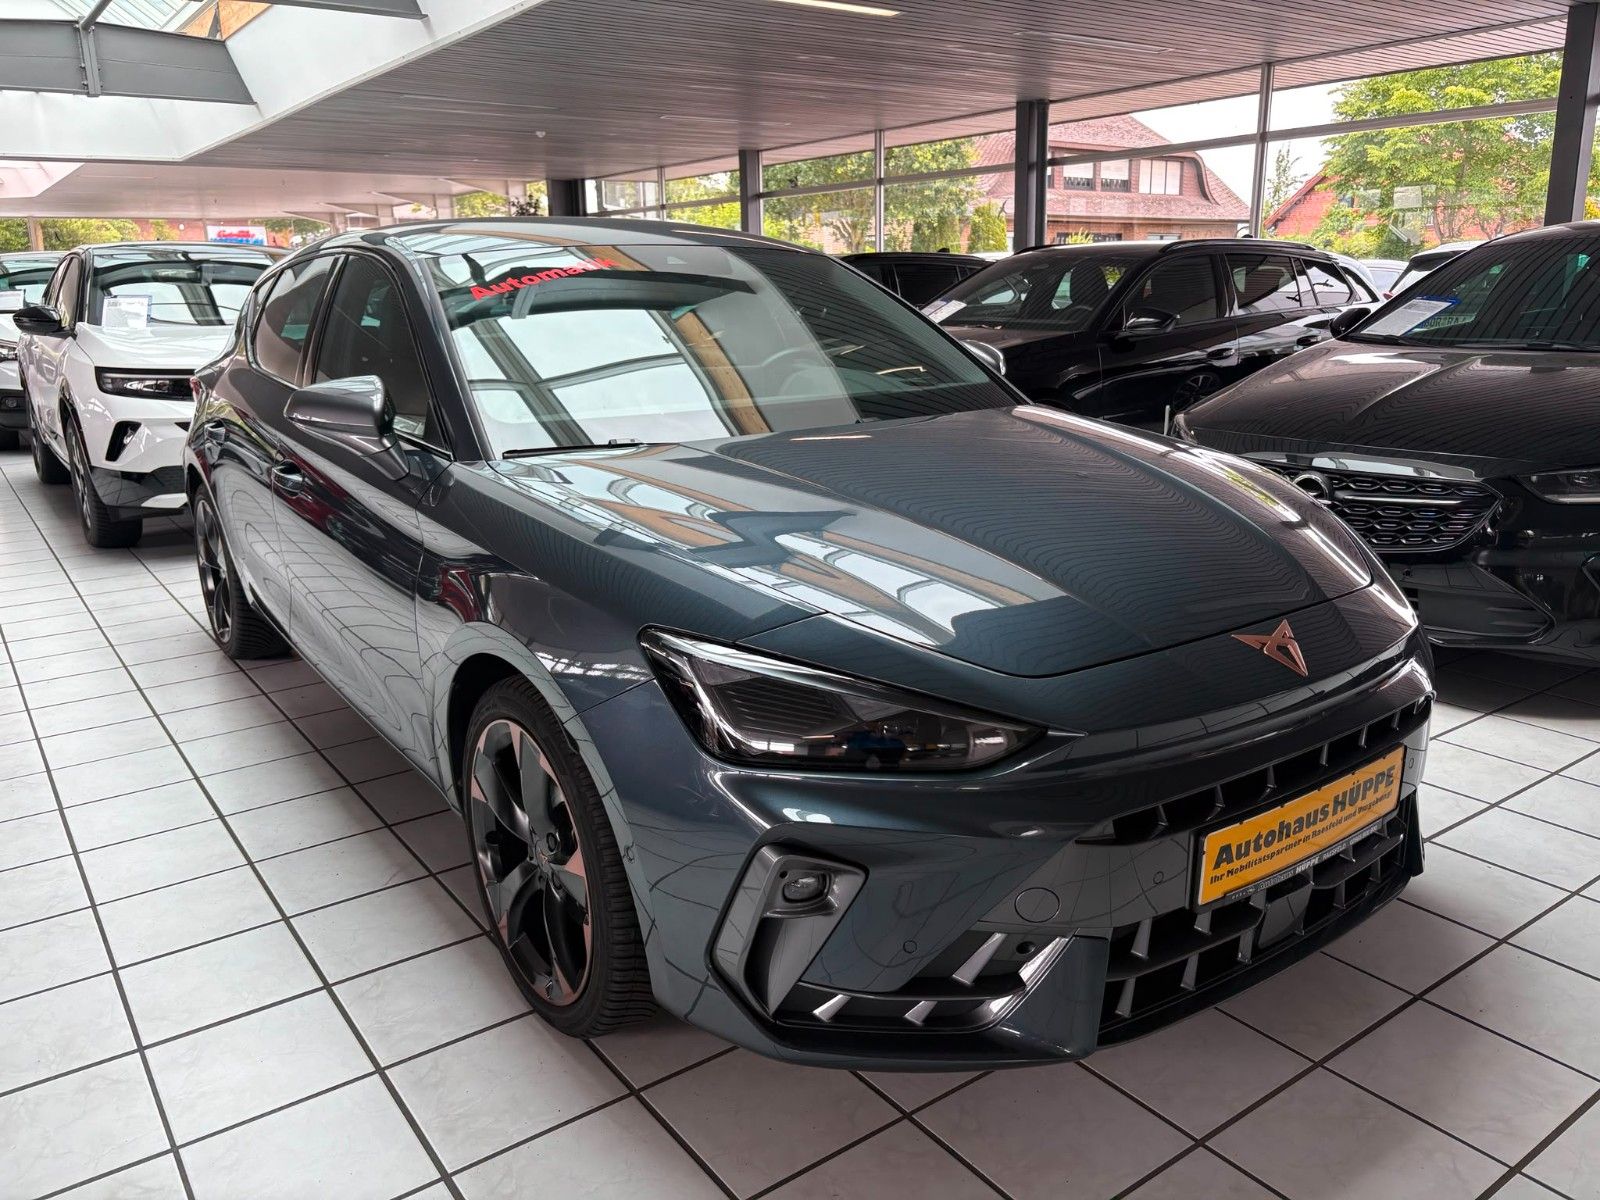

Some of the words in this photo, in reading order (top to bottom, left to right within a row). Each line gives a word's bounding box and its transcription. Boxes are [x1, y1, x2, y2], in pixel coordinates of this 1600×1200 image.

[469, 256, 619, 301] Automatik
[1209, 872, 1226, 885] Ihr
[1311, 816, 1344, 839] Raesfeld
[1212, 803, 1330, 871] Autohaus
[1331, 764, 1396, 817] HÜPPE
